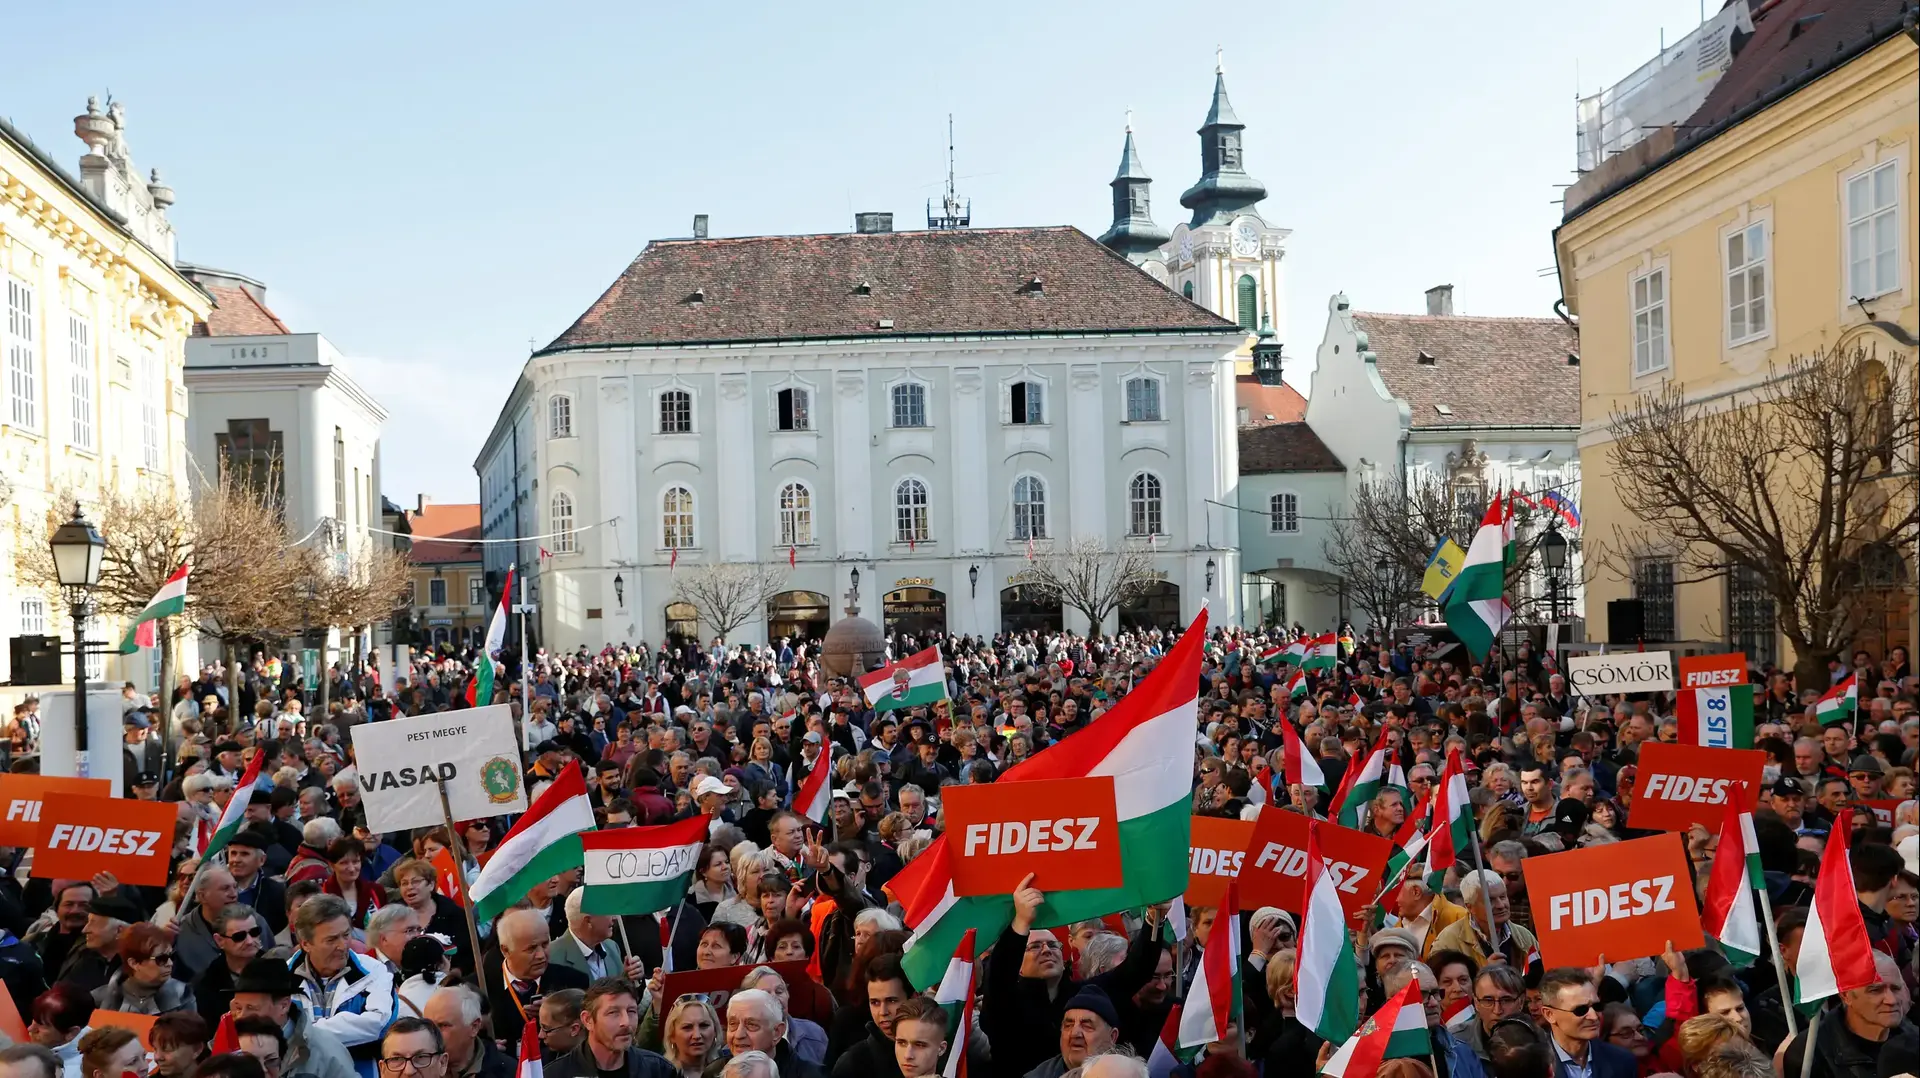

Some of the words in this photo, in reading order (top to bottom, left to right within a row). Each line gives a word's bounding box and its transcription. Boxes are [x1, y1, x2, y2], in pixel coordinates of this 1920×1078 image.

[1571, 661, 1671, 686] CSÖMÖR
[1686, 669, 1740, 687] FIDESZ
[1707, 694, 1727, 711] 8.
[407, 731, 430, 742] PEST
[432, 725, 467, 739] MEGYE
[360, 761, 457, 793] VASAD
[48, 823, 161, 857] FIDESZ
[964, 816, 1100, 857] FIDESZ
[1254, 841, 1370, 894] FIDSZ
[1550, 874, 1675, 931] FIDESZ
